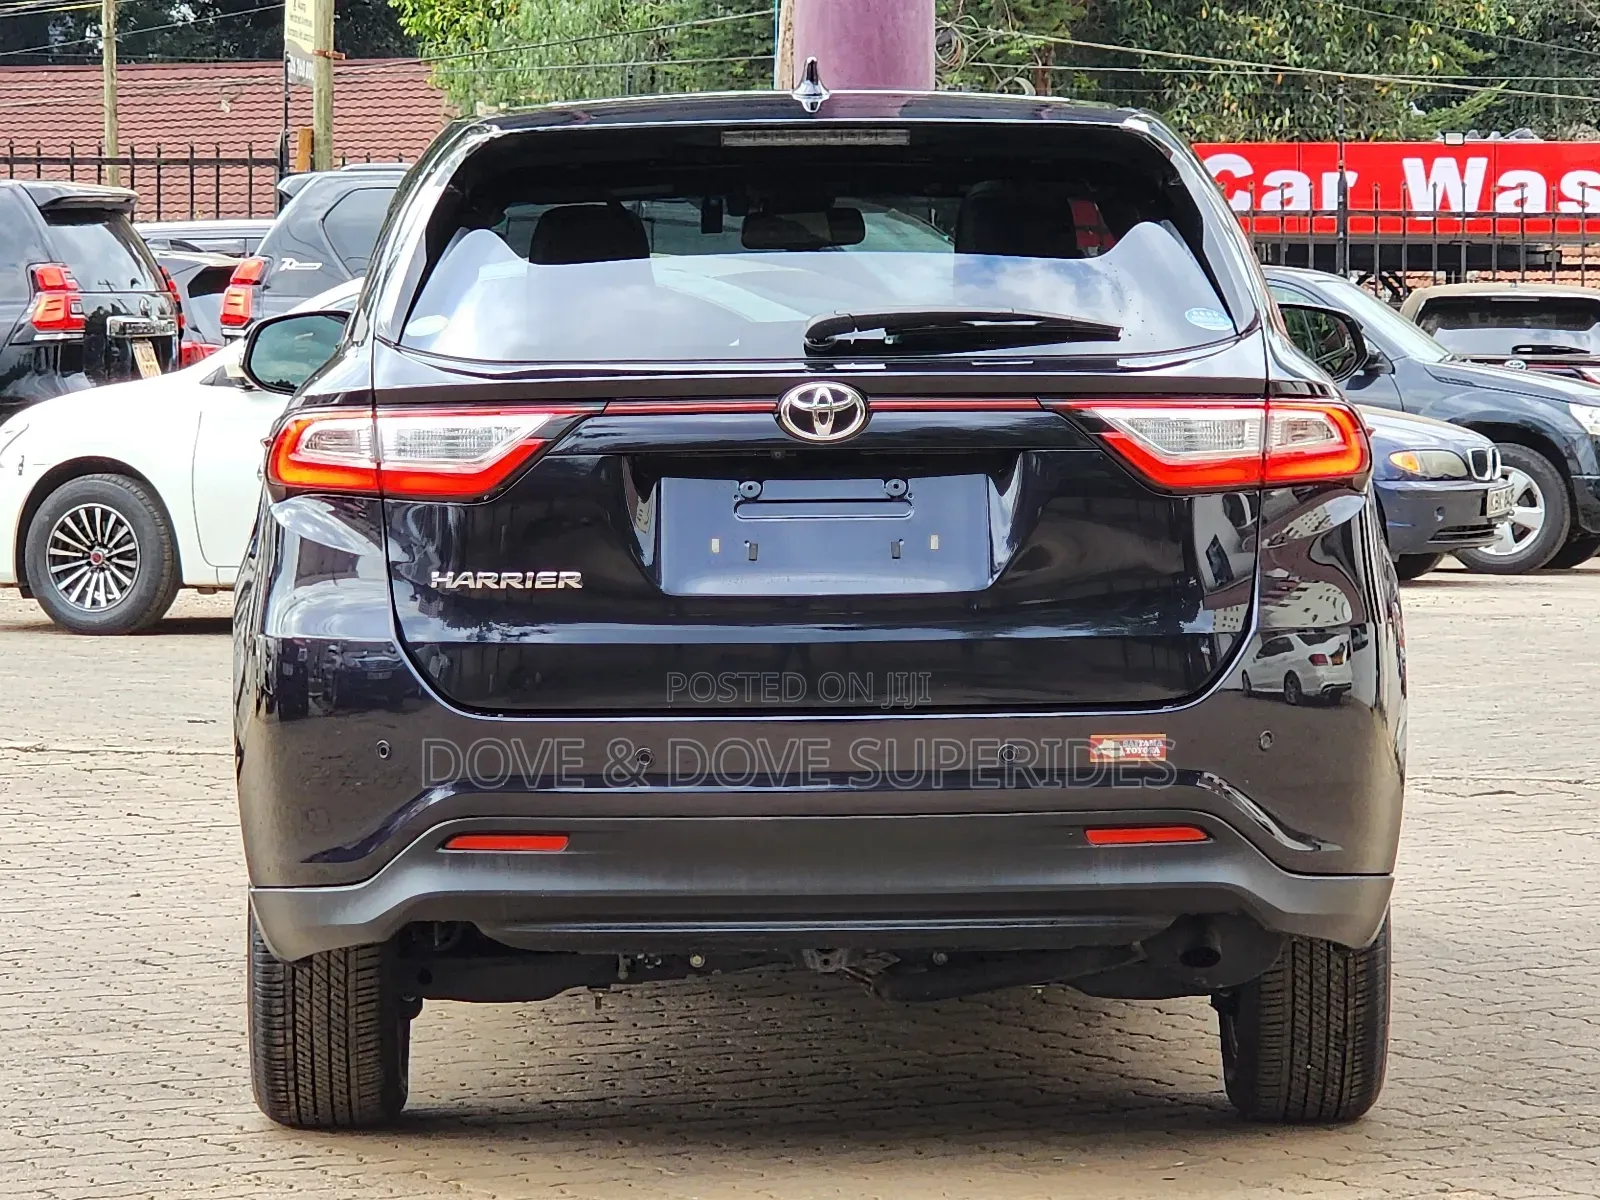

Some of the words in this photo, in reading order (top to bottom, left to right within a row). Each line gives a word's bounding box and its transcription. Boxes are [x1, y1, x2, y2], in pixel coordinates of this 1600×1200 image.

[1203, 153, 1358, 218] Car
[1402, 157, 1600, 220] Was
[430, 571, 583, 589] HARRIER
